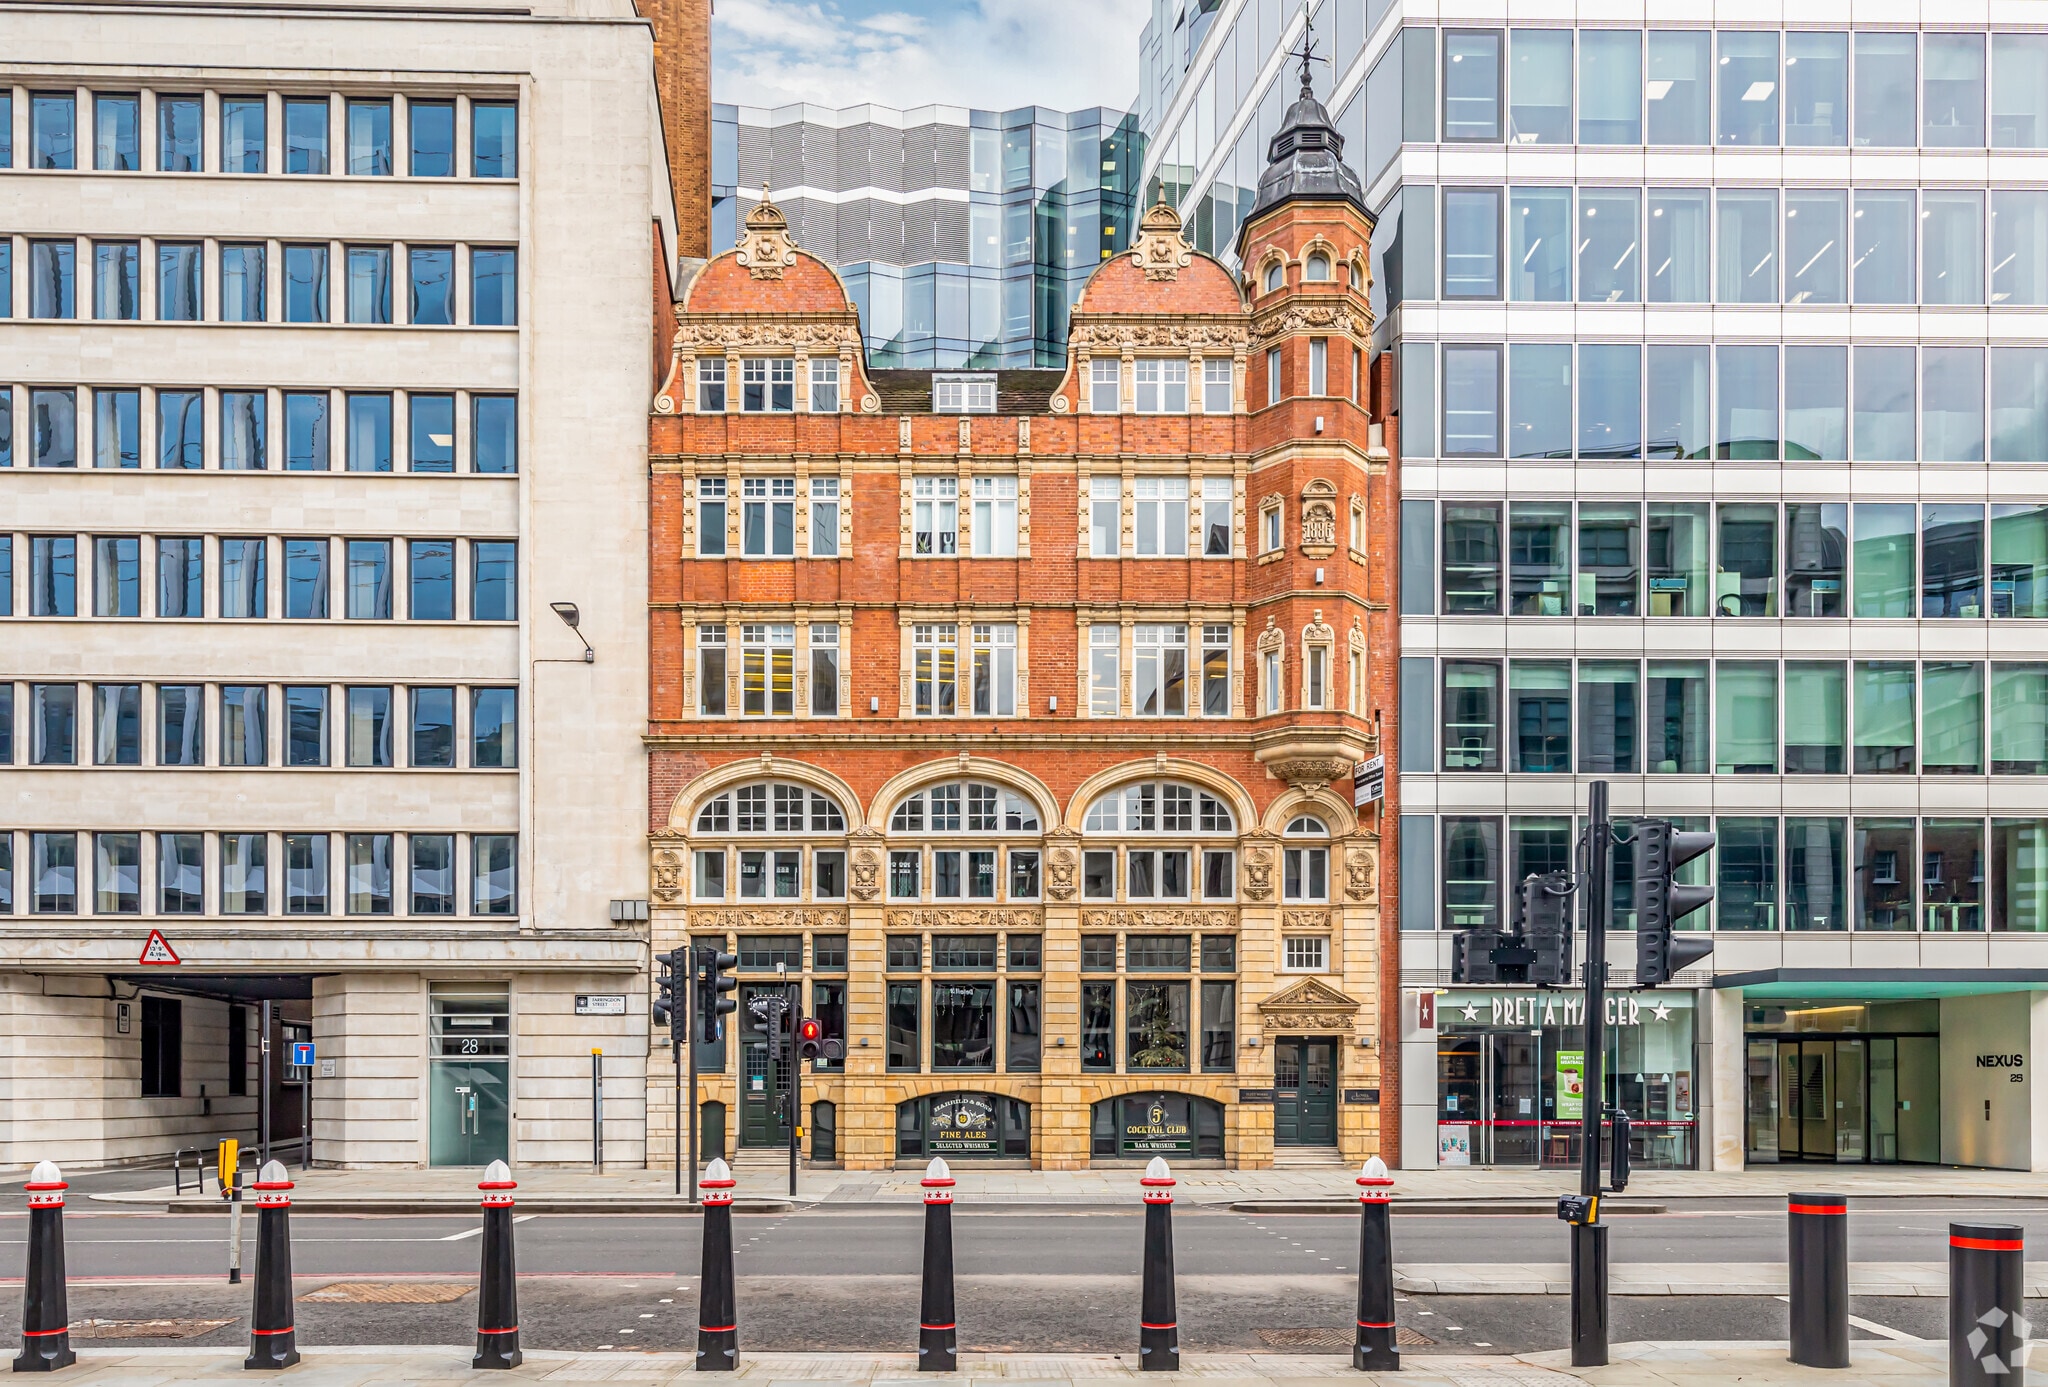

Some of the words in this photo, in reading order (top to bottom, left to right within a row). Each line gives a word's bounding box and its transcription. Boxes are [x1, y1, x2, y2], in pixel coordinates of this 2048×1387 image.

[1305, 522, 1331, 538] 1886
[1355, 765, 1364, 775] FOR
[1366, 759, 1379, 770] RENT
[1492, 997, 1536, 1025] PRET
[1543, 997, 1556, 1025] A
[1564, 996, 1640, 1025] MAGER
[461, 1038, 479, 1054] 28
[1976, 1054, 2023, 1067] NEXUS
[2010, 1073, 2023, 1083] 25
[934, 1098, 969, 1112] HARRILD
[975, 1101, 993, 1112] SONS
[940, 1131, 961, 1139] FINE
[964, 1131, 987, 1139] ALES
[1127, 1125, 1165, 1134] COCKTAIL
[1166, 1125, 1187, 1134] CLUB
